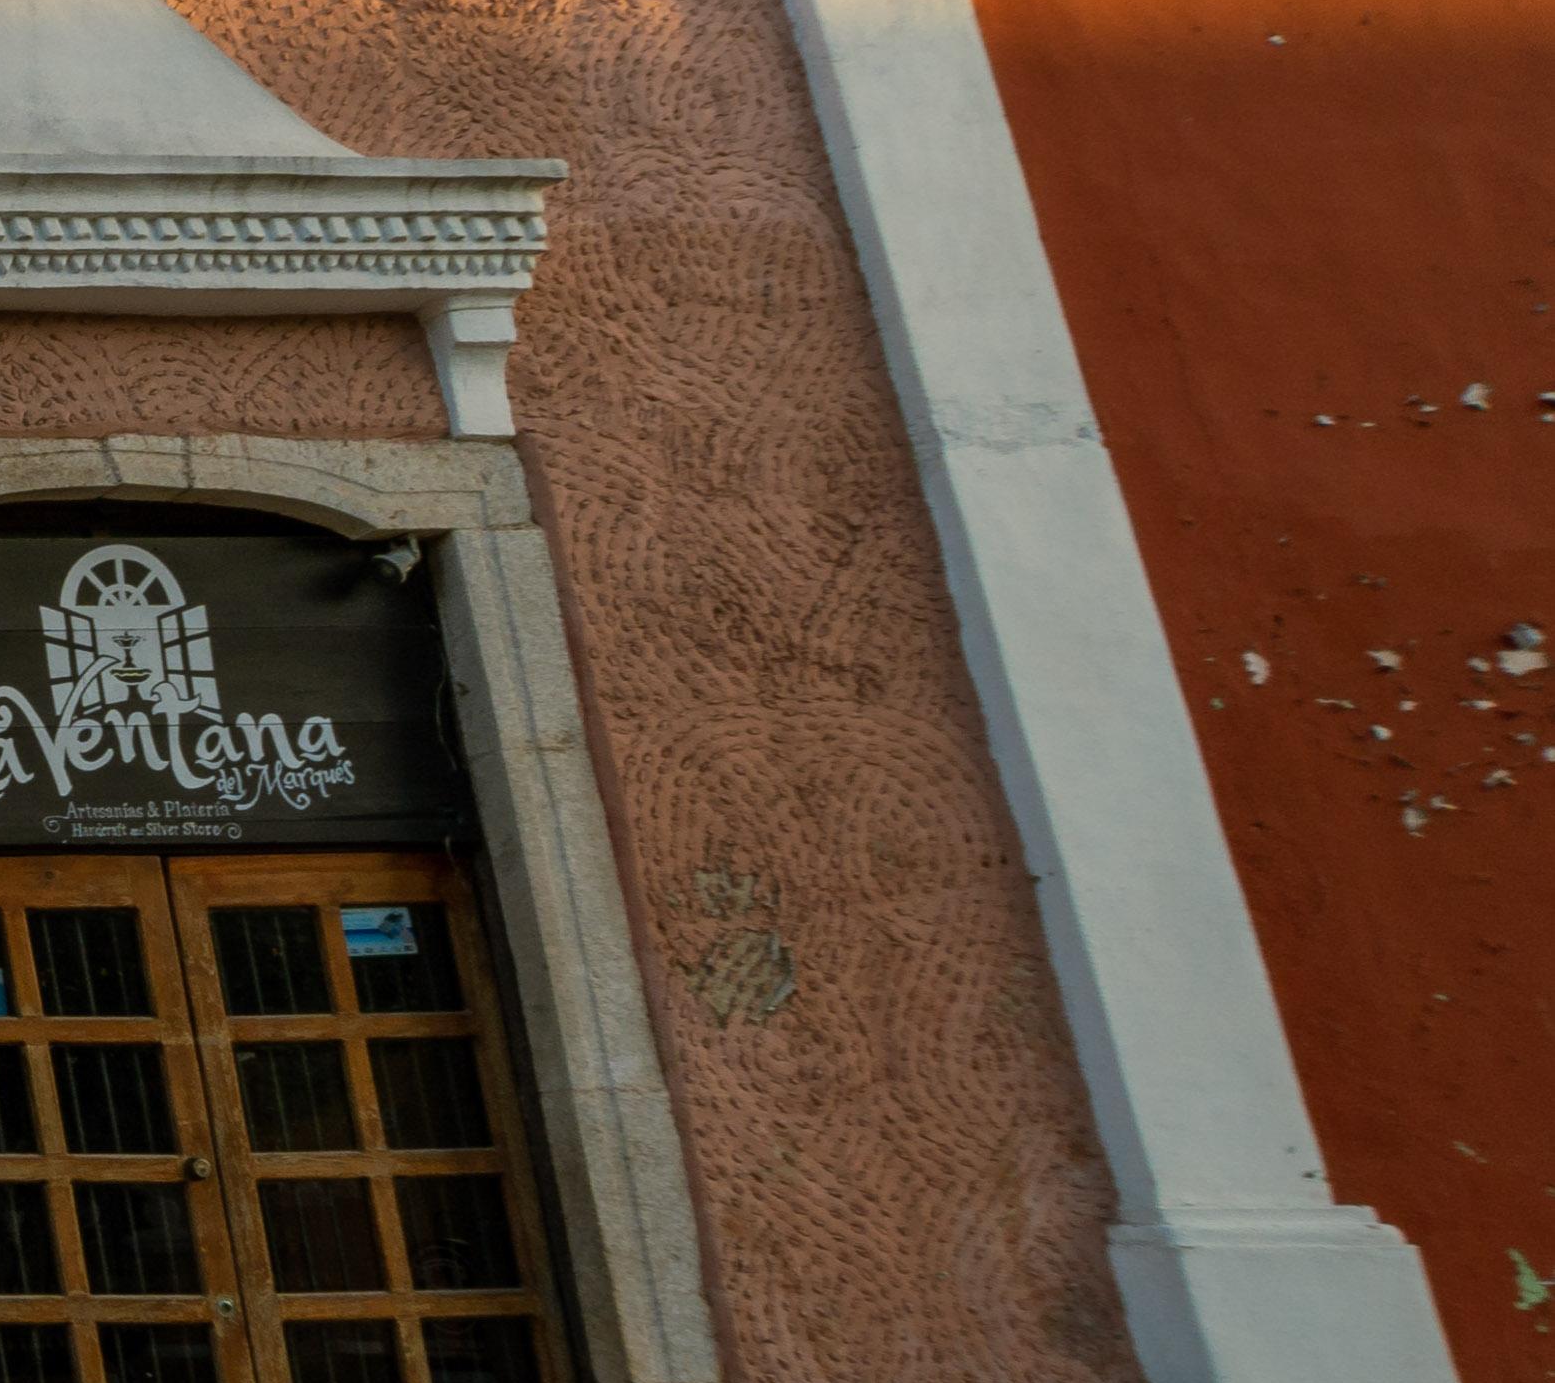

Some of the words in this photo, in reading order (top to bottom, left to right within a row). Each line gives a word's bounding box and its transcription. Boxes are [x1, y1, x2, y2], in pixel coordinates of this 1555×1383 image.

[216, 767, 246, 800] del
[234, 759, 356, 810] Marqués
[147, 800, 160, 818] &
[182, 822, 221, 836] Store
